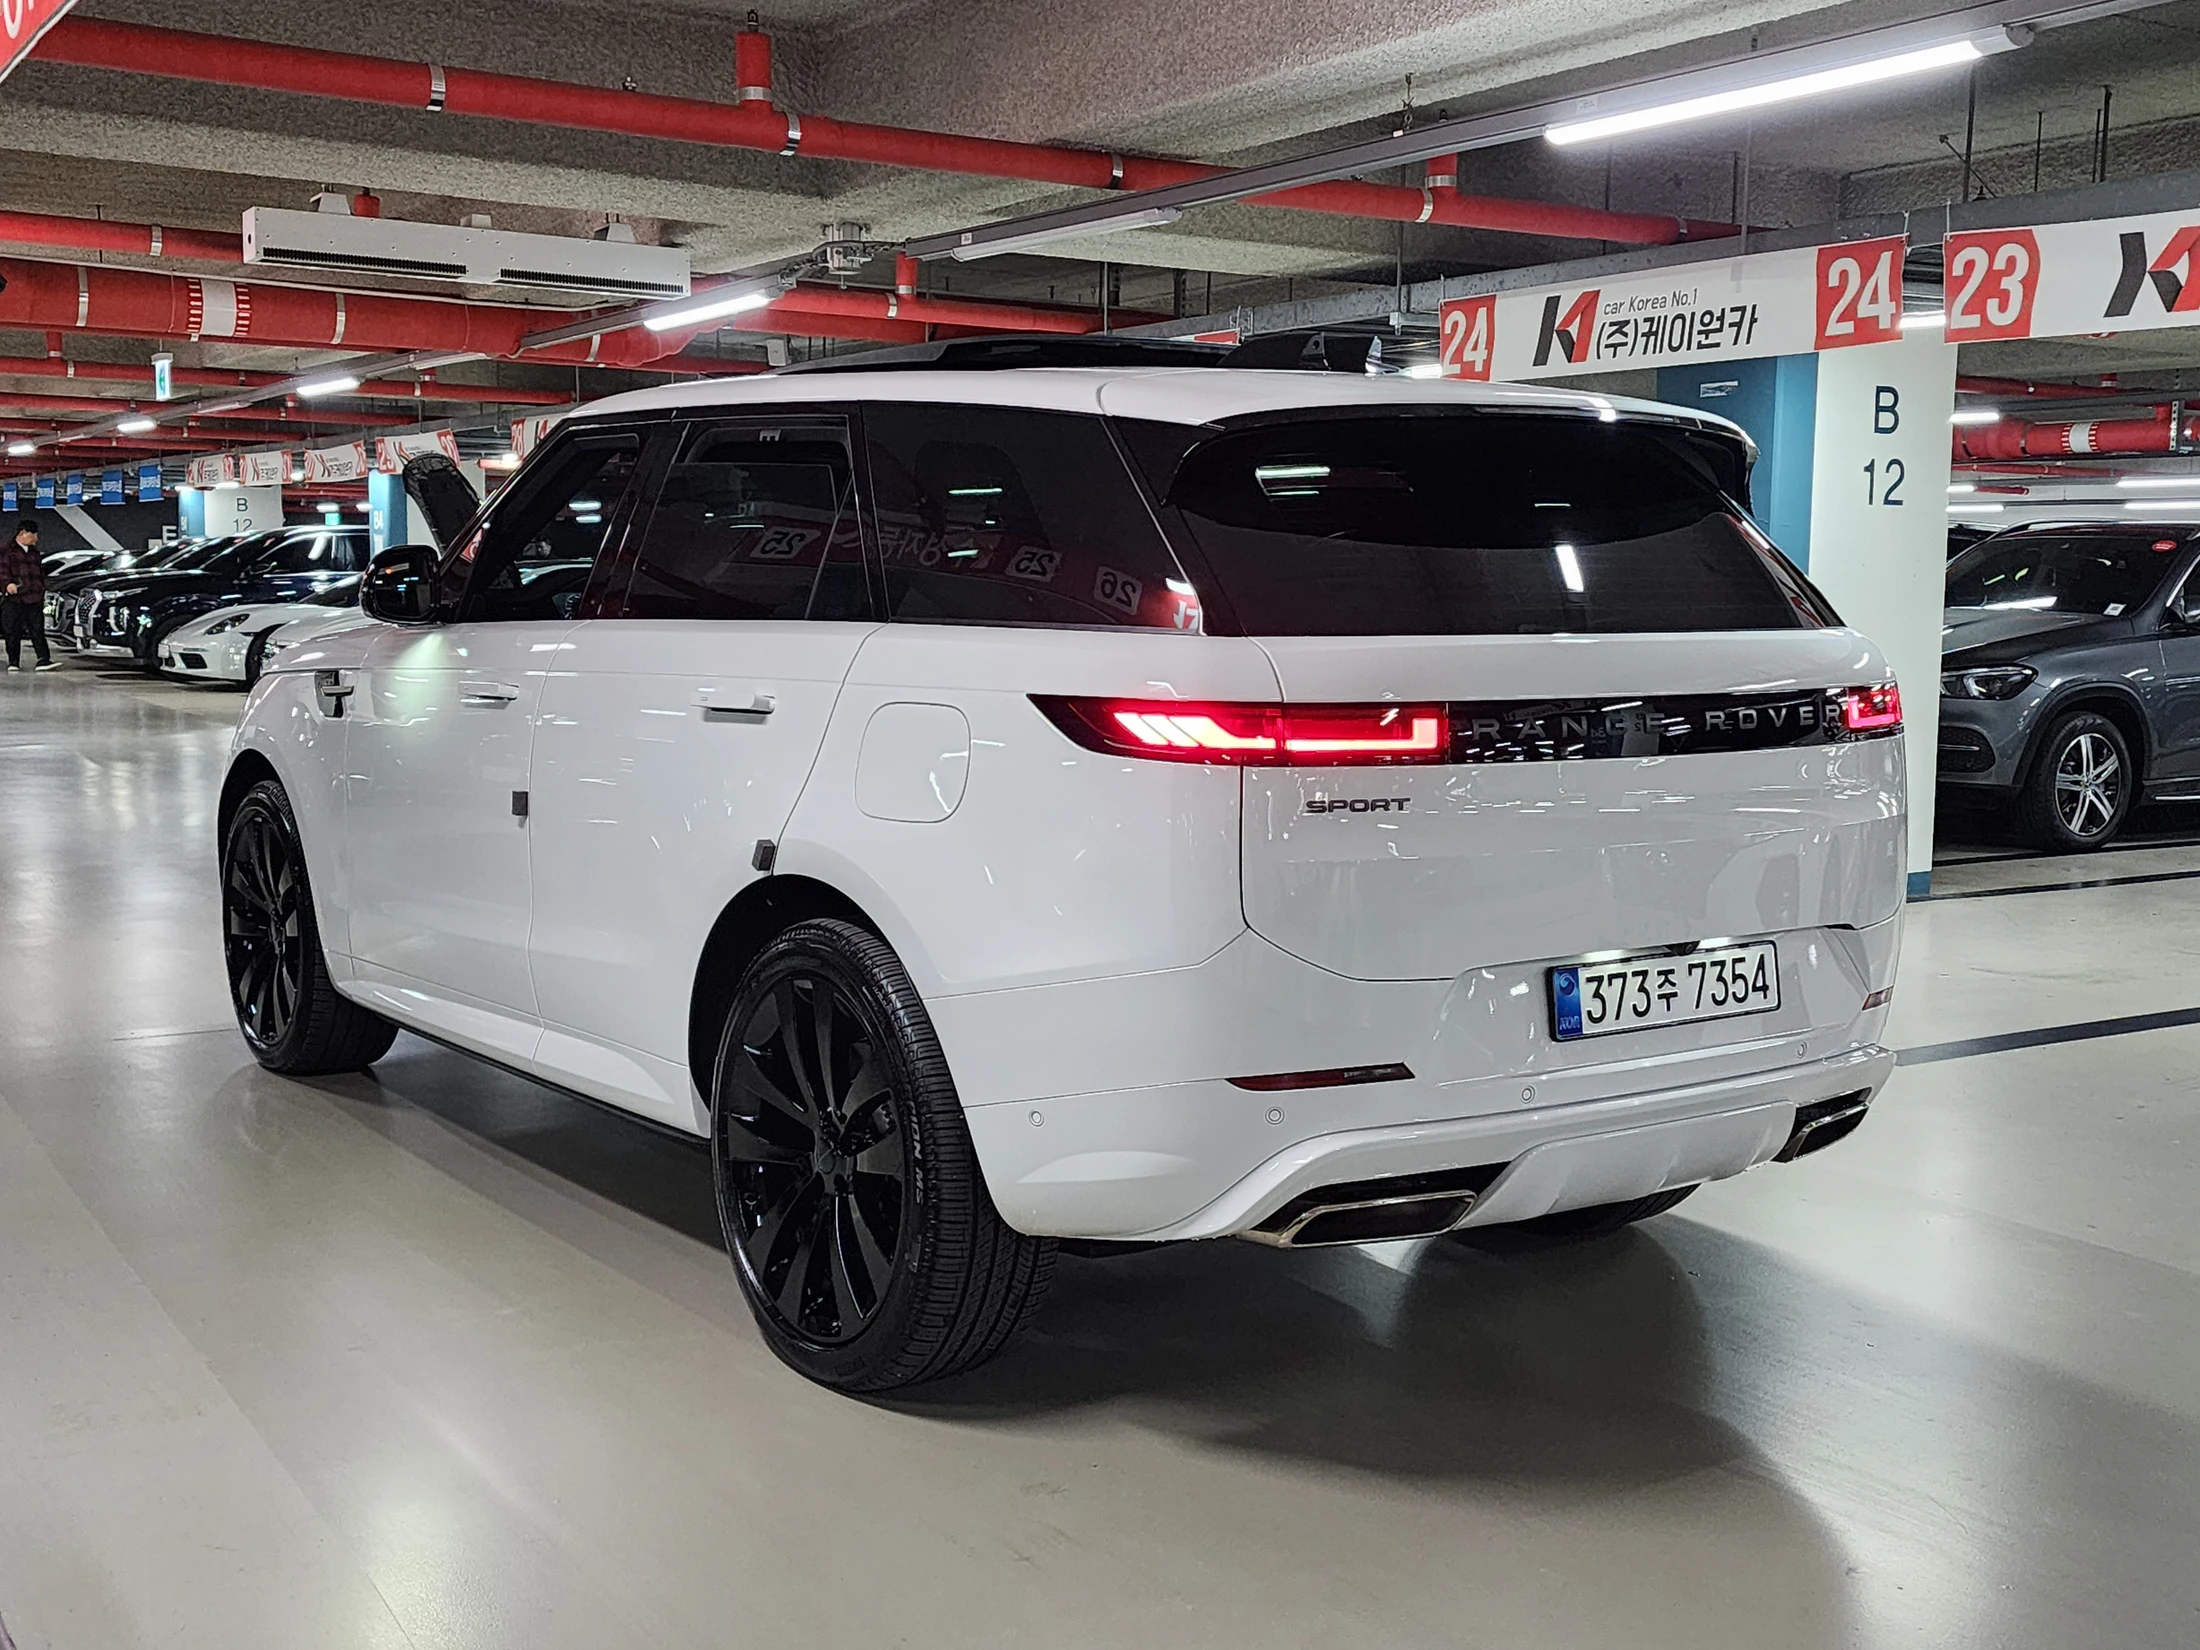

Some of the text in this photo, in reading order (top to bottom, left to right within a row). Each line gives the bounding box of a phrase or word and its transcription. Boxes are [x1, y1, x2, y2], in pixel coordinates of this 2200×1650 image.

[1603, 287, 1699, 315] car Korea No.1
[1825, 251, 1896, 337] 24
[1950, 243, 2030, 330] 23
[1443, 307, 1488, 374] 24
[1596, 303, 1758, 360] (주)케이원카
[1874, 385, 1900, 434] B
[236, 498, 248, 512] B
[1863, 458, 1905, 506] 12
[232, 518, 253, 531] 12
[1472, 712, 1665, 741] RANGE
[1705, 705, 1841, 731] ROVER
[1306, 797, 1411, 814] SPORT
[1585, 953, 1770, 1024] 373주 7354
